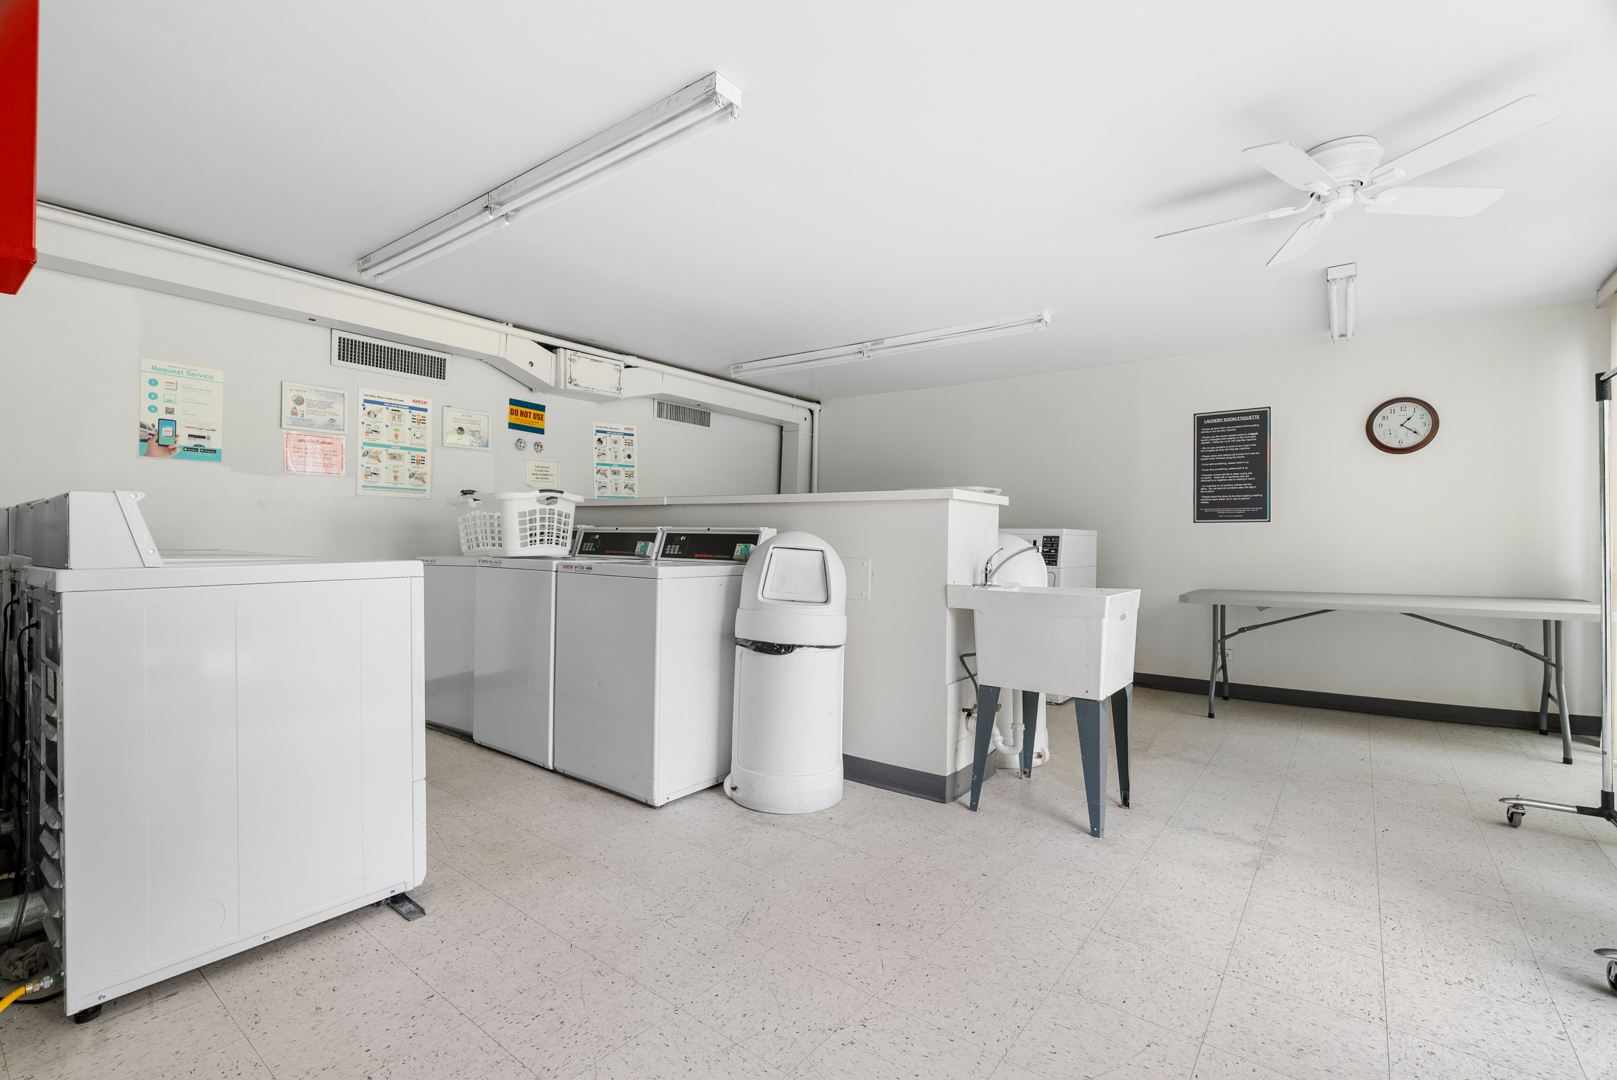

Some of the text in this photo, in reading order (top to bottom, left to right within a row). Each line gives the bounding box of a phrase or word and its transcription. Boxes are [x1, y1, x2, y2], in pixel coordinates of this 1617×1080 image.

[151, 365, 214, 380] Request Service
[510, 408, 518, 416] DO
[520, 410, 532, 419] NOT
[532, 413, 544, 421] USE
